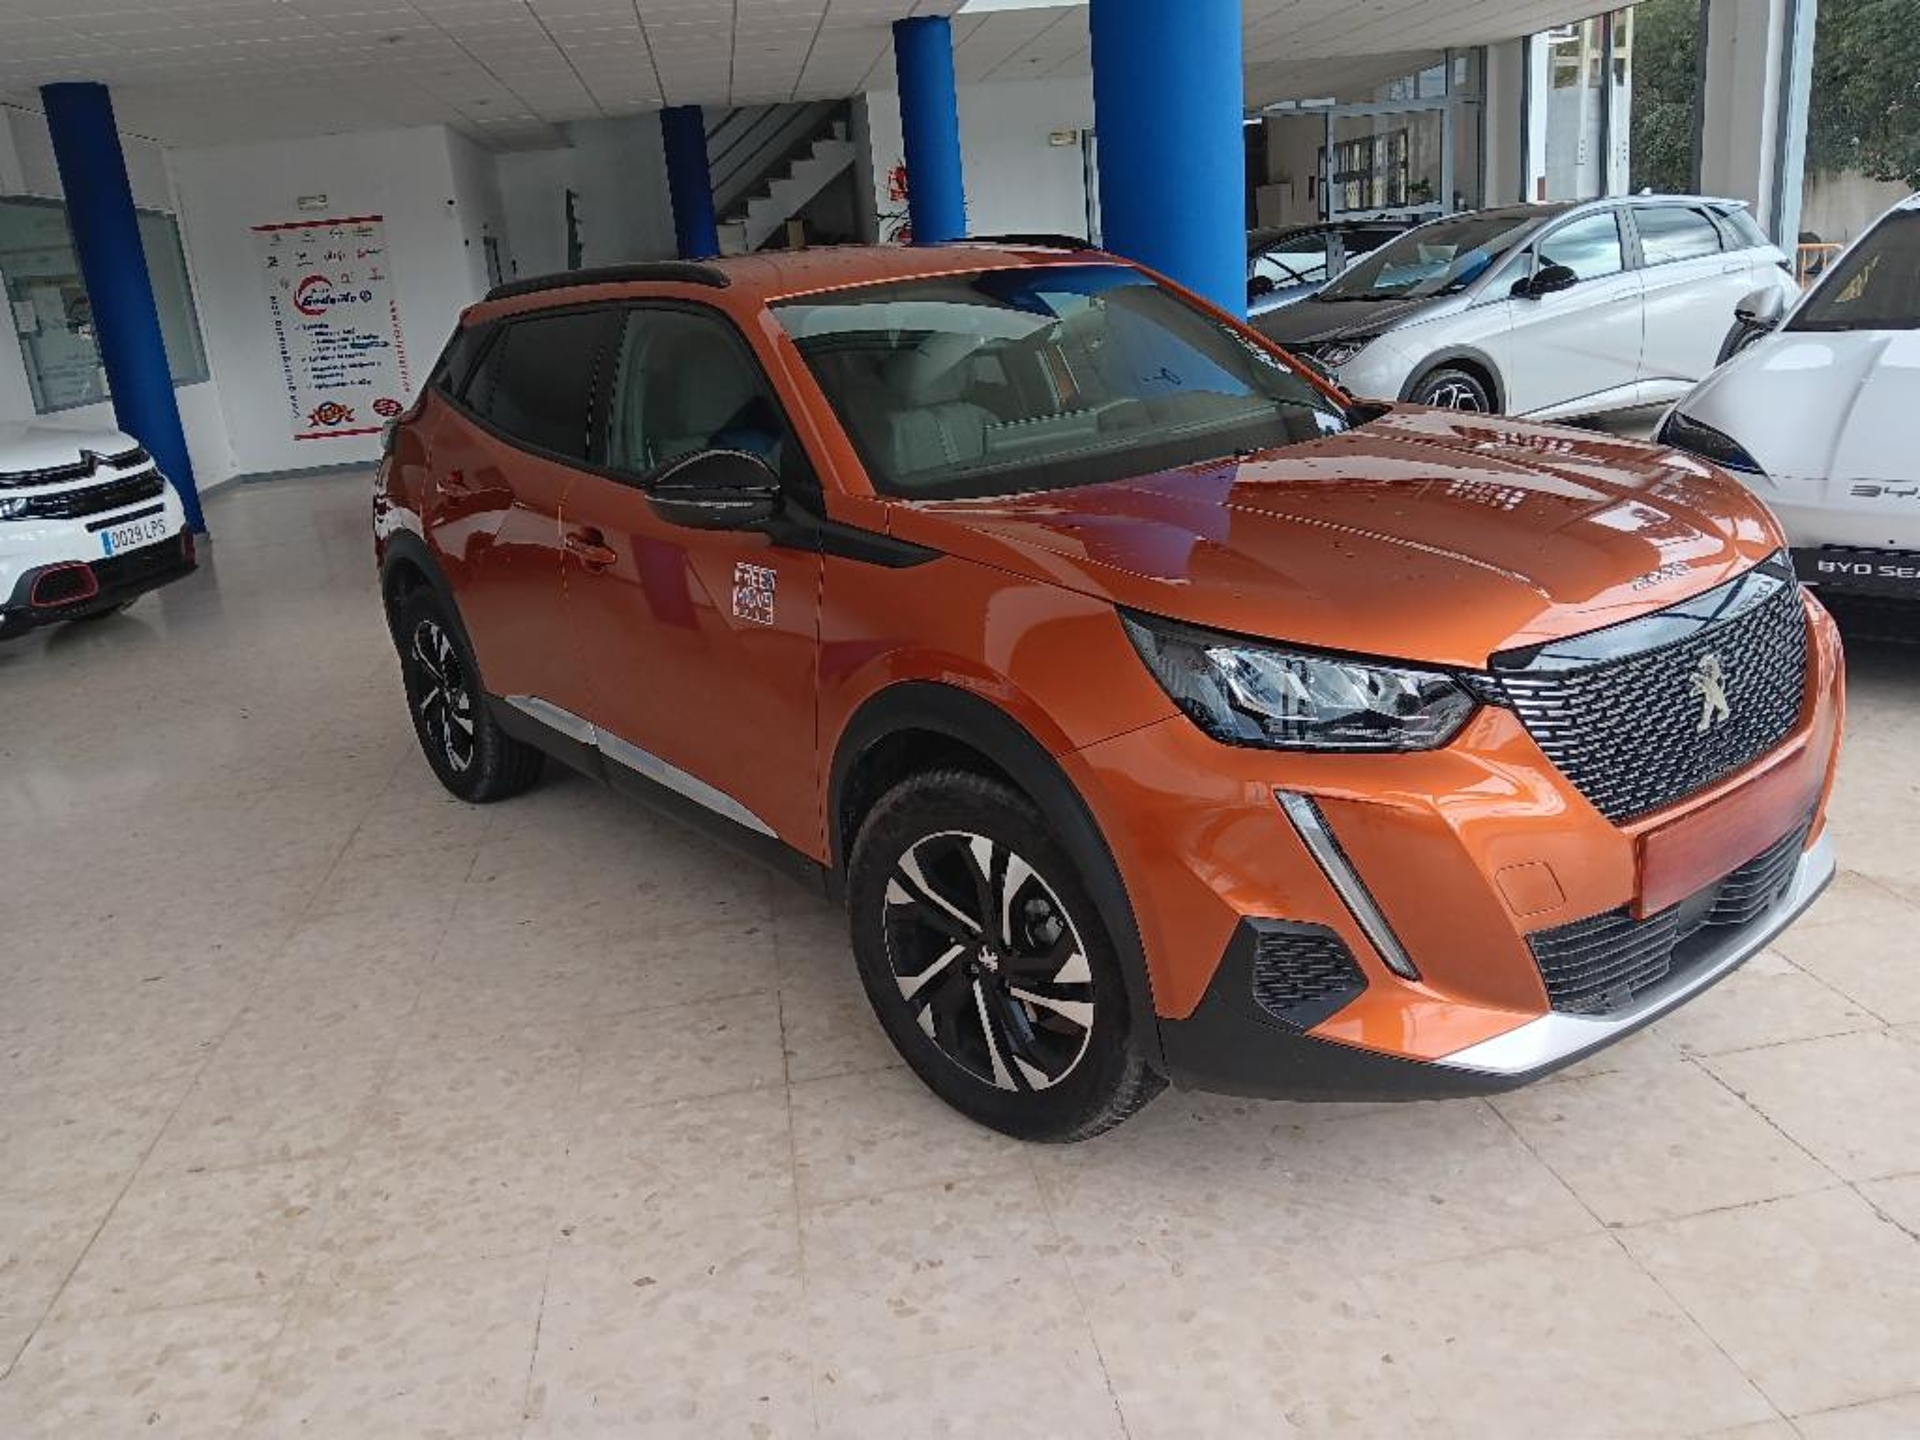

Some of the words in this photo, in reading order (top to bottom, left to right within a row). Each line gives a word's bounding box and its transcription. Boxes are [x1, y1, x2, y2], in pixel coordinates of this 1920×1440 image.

[1849, 484, 1920, 500] BY
[112, 525, 143, 549] 0029
[143, 519, 166, 540] LPS
[1818, 560, 1873, 575] BYD
[1877, 565, 1920, 579] SE
